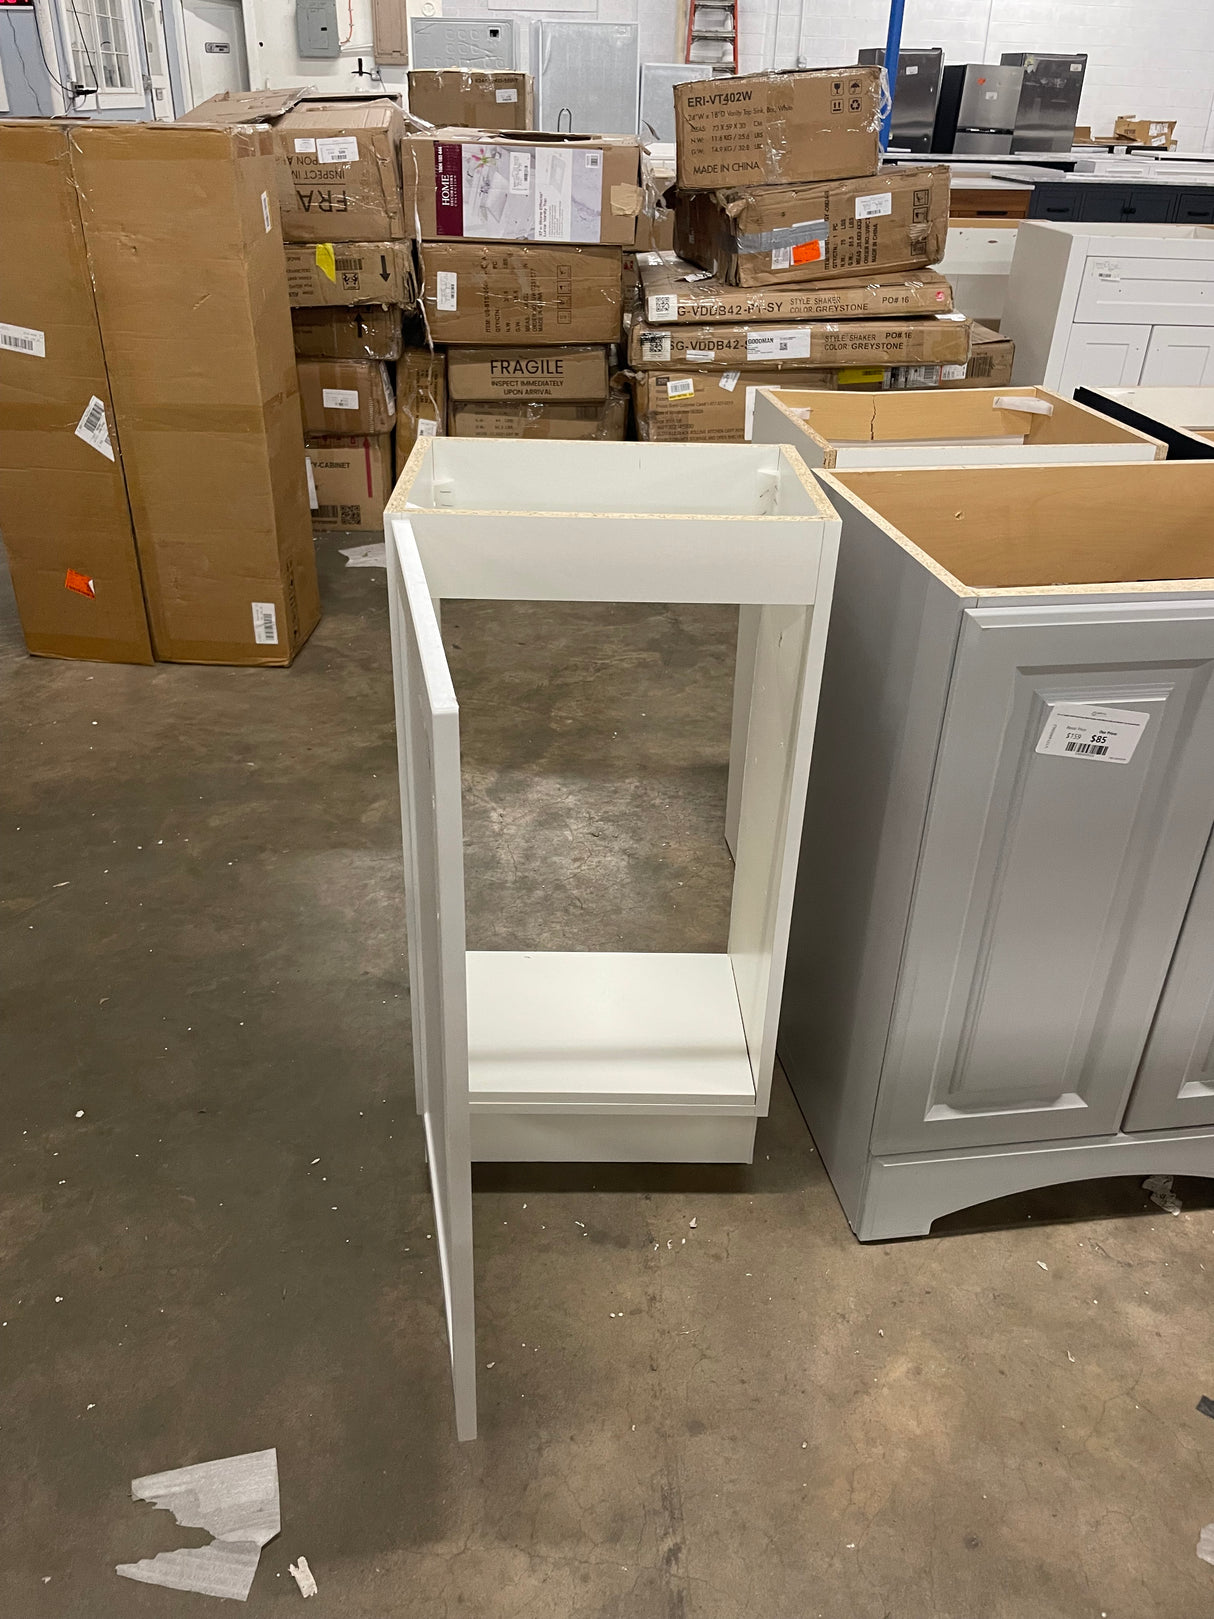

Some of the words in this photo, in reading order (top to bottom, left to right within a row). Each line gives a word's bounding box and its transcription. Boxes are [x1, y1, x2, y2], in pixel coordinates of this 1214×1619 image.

[688, 90, 752, 108] ERI-VT402W
[304, 170, 345, 179] INSPECT
[693, 163, 718, 175] MADE
[720, 163, 730, 172] IN
[732, 161, 760, 172] CHINA
[442, 175, 450, 206] HOME
[816, 304, 869, 313] GREYSTONE
[490, 360, 563, 374] FRAGILE
[1090, 734, 1107, 744] $85
